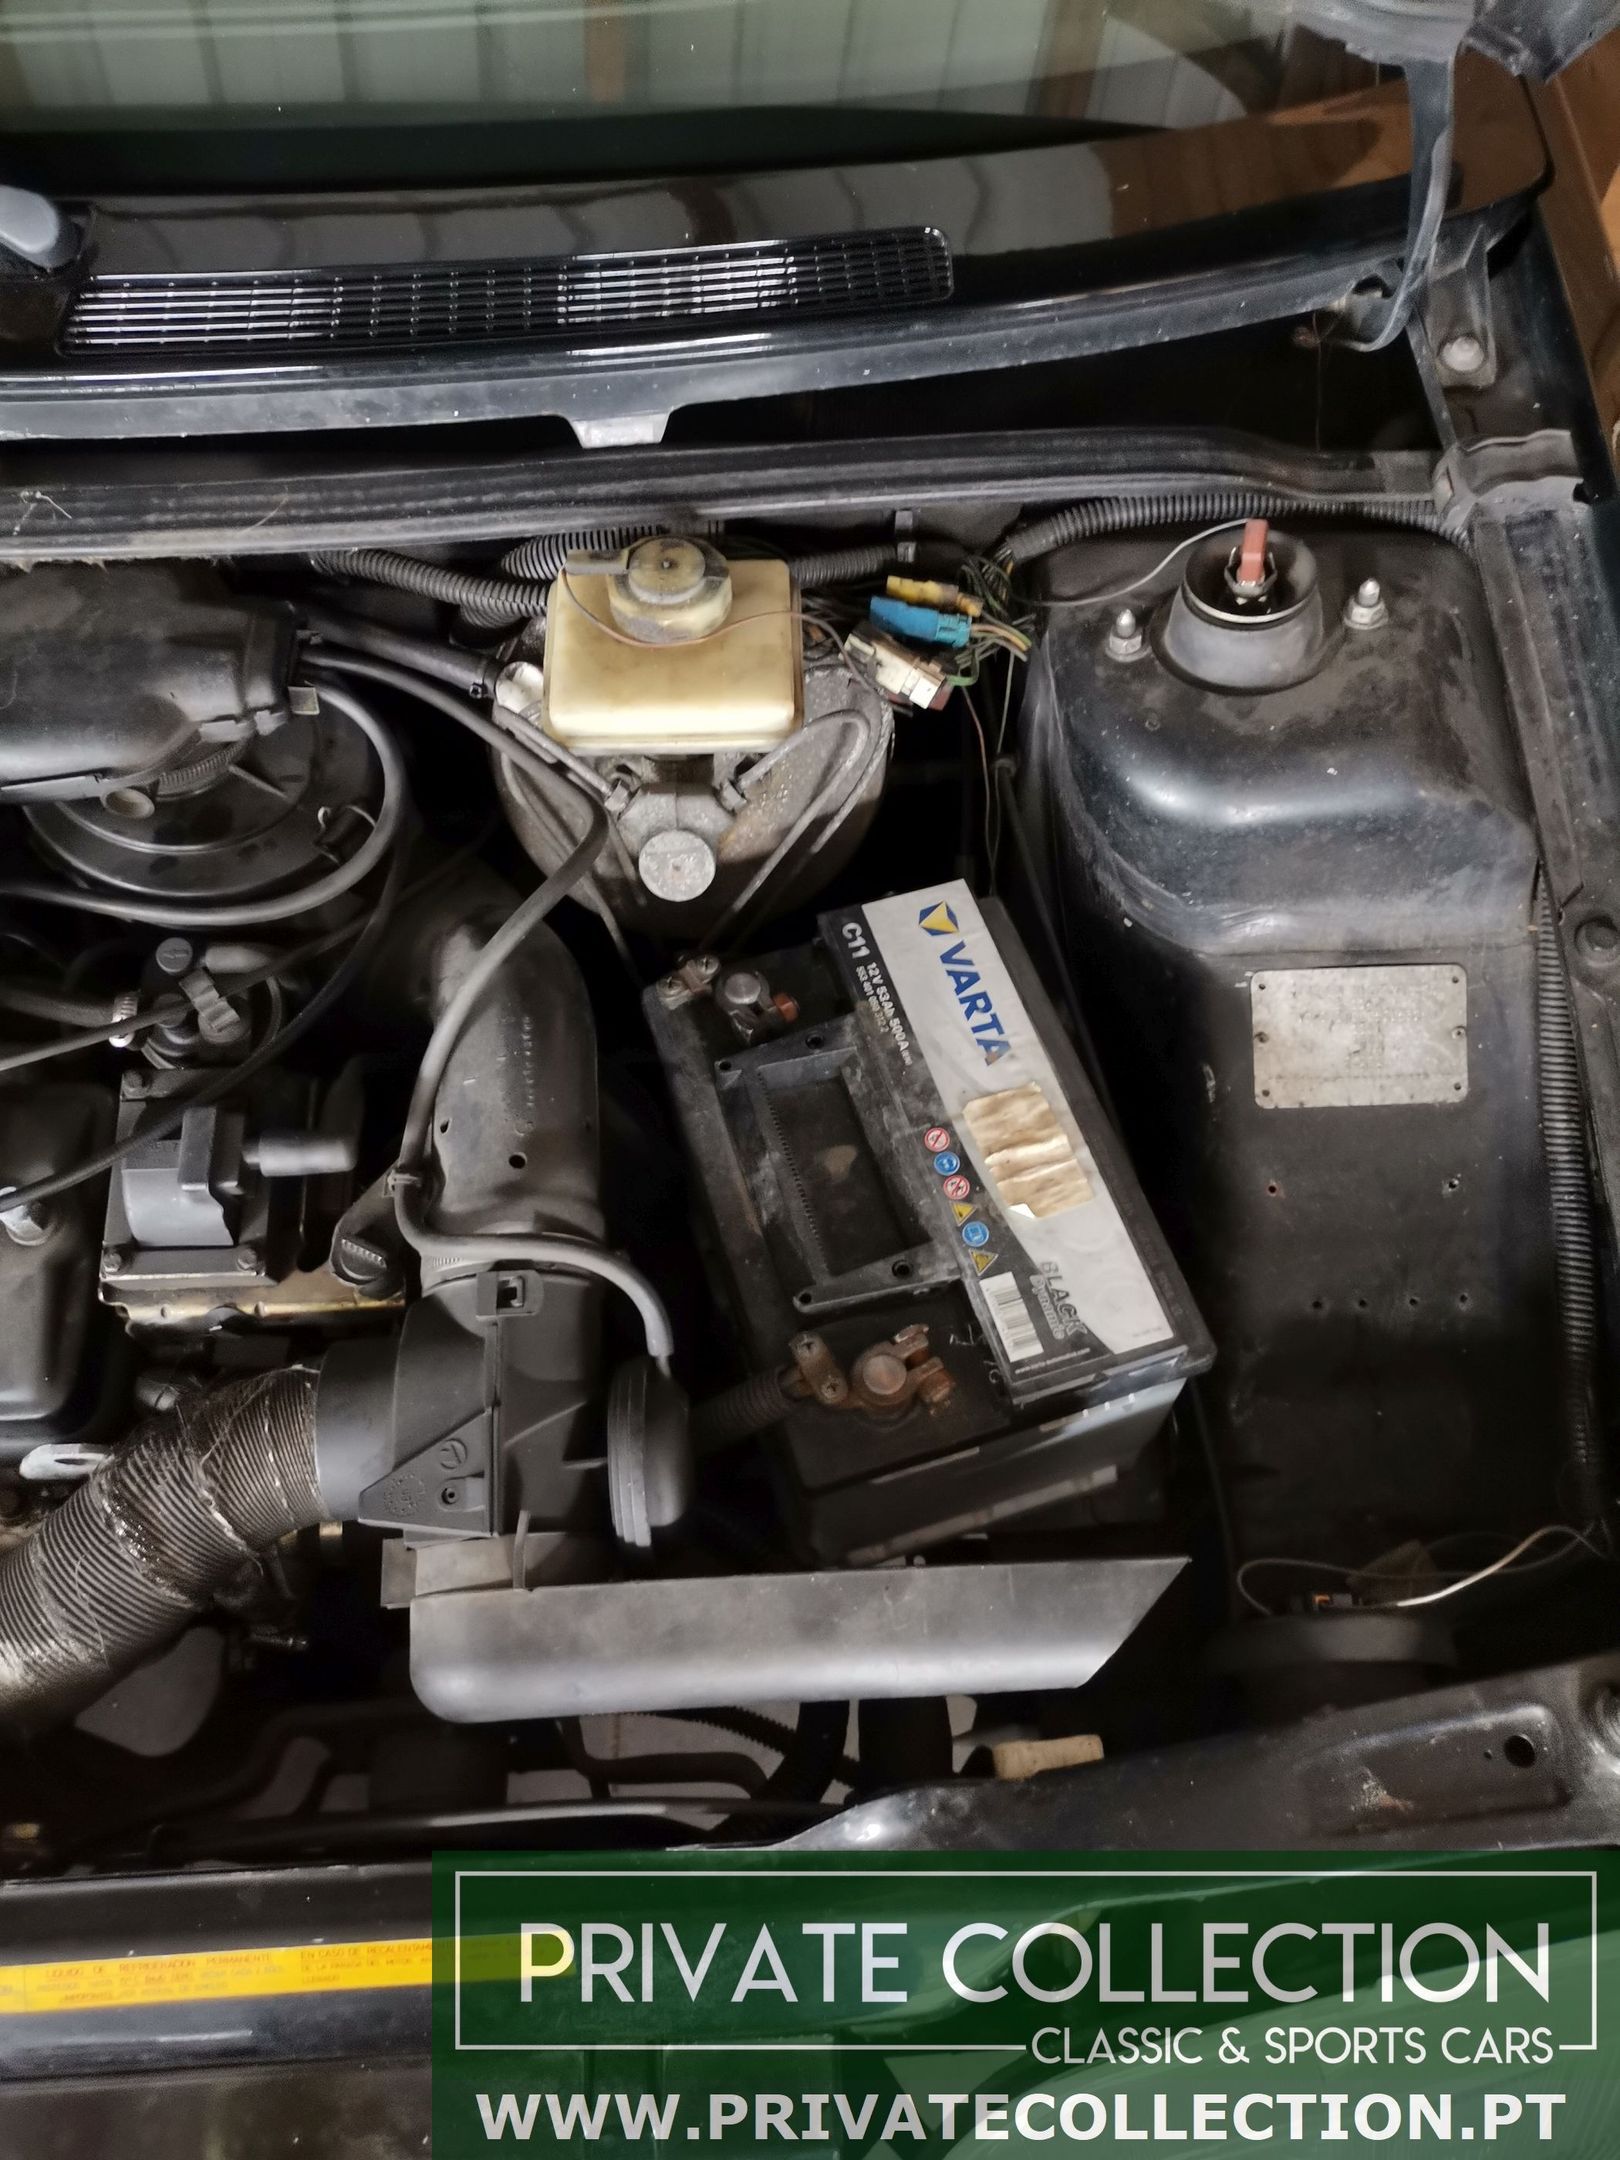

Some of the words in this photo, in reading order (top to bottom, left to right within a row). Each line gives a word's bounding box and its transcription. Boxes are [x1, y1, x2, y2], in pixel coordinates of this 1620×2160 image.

[842, 922, 870, 959] C11
[866, 961, 884, 985] 12V
[889, 1017, 910, 1051] 500A
[940, 940, 1011, 1066] VARTA
[1029, 1274, 1066, 1340] Dynamic
[1040, 1261, 1088, 1336] BLACK
